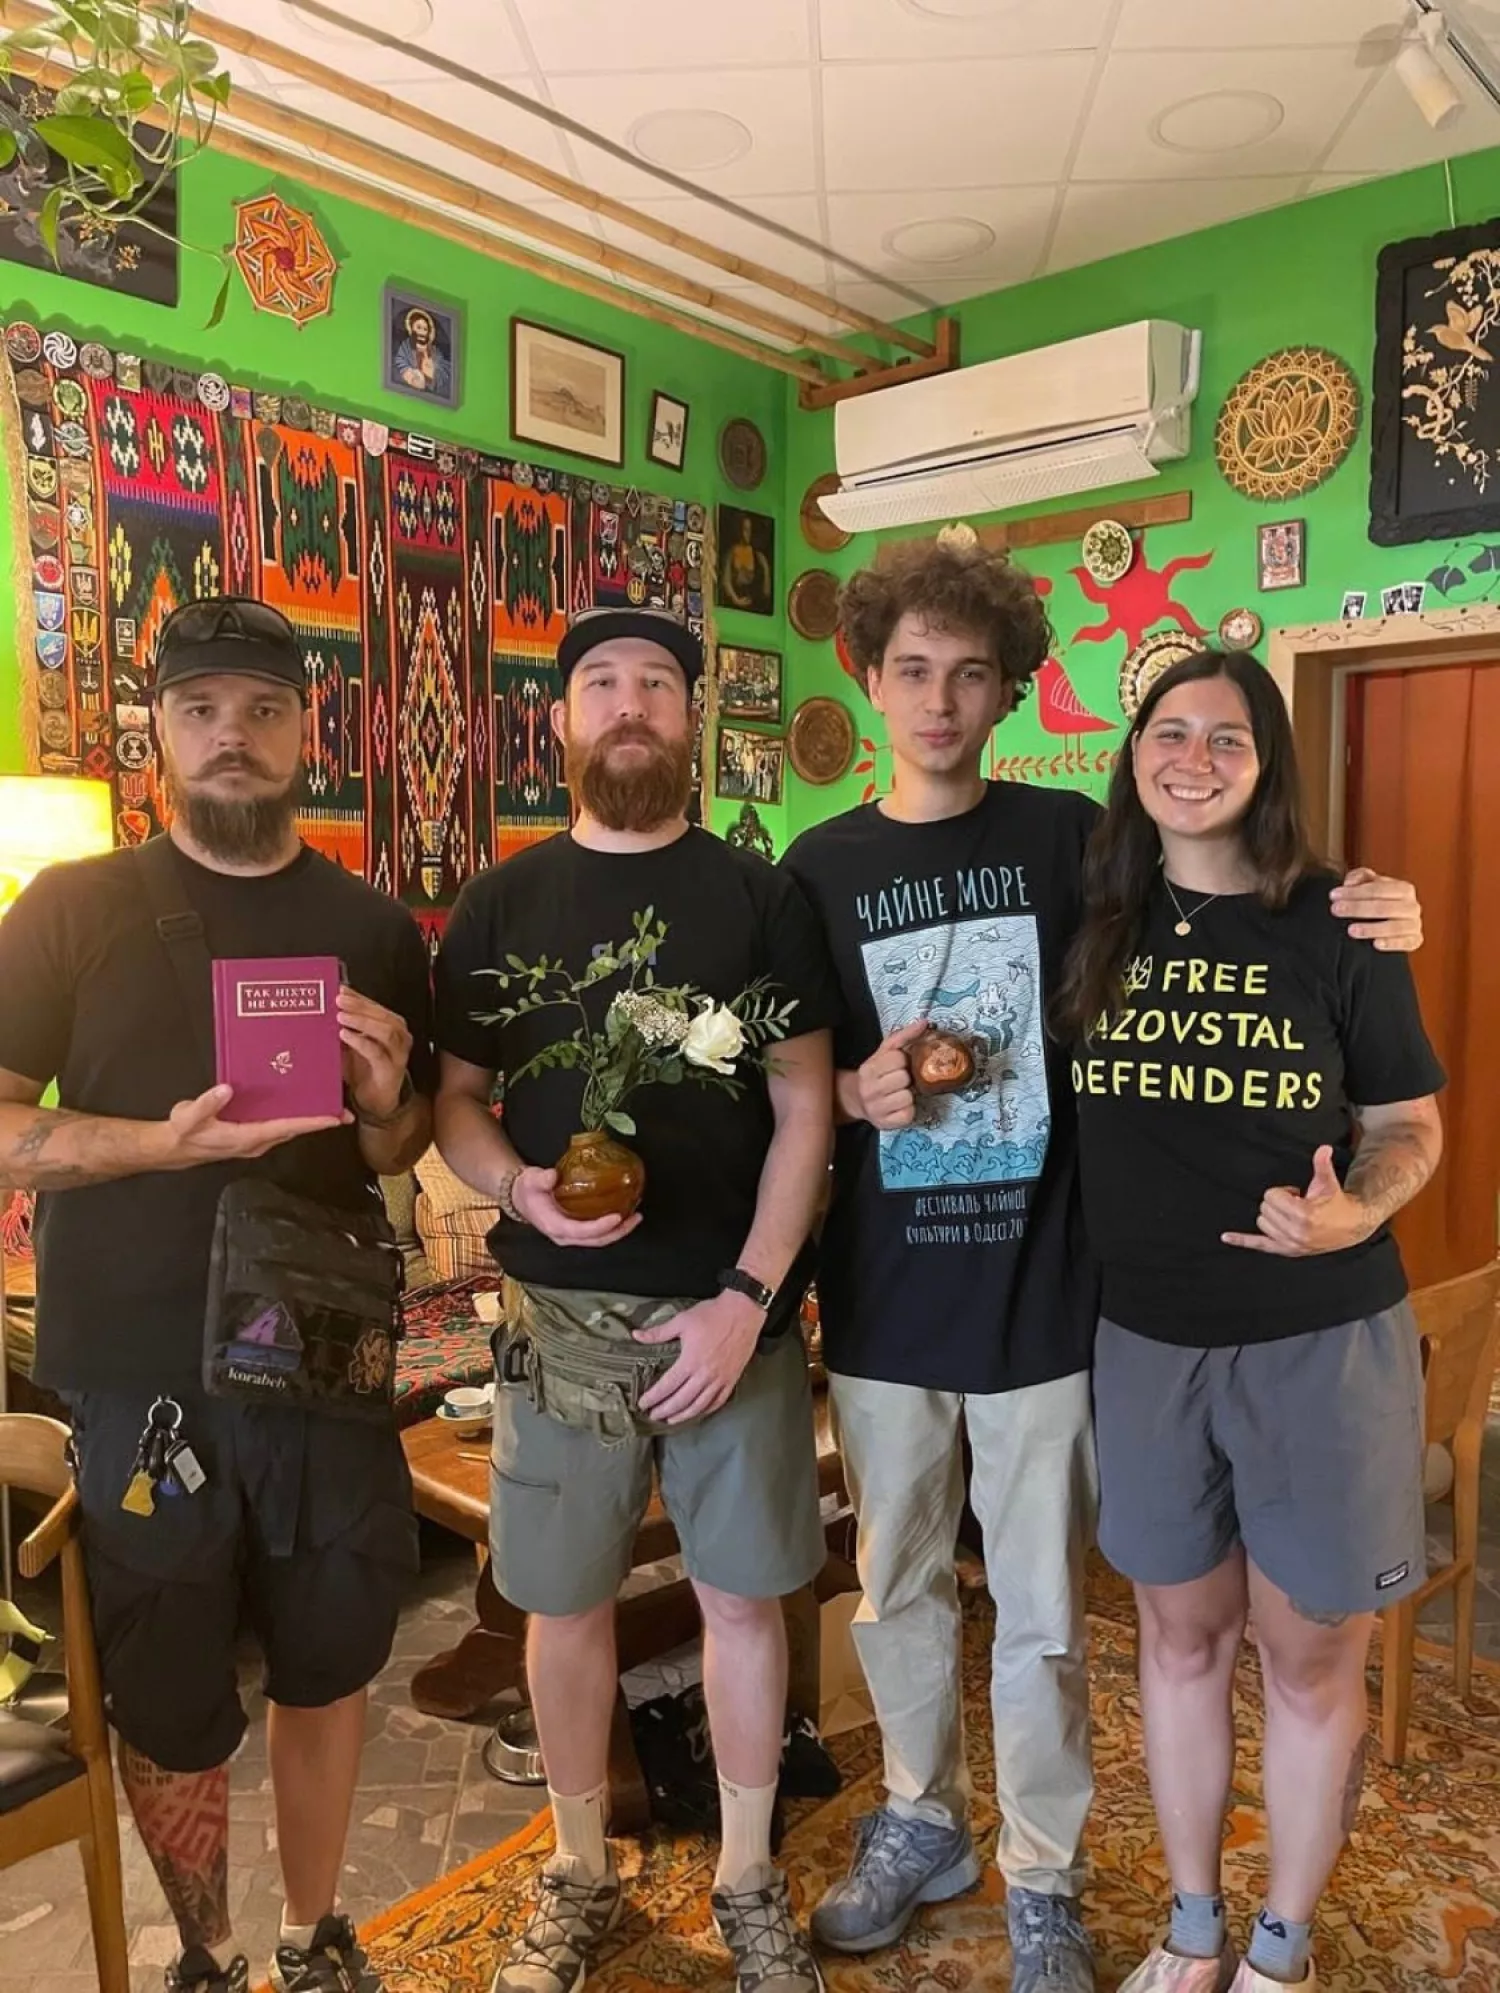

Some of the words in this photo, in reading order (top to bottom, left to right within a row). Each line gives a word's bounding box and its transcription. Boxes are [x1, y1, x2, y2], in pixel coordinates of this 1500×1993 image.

[856, 875, 949, 933] ЧАЙНЕ
[955, 865, 1032, 913] МОРЕ
[244, 988, 271, 998] ТАК
[275, 987, 317, 997] НІХТО
[1162, 958, 1269, 995] FREE
[247, 1001, 266, 1009] НЕ
[271, 998, 315, 1008] КОХАВ
[1071, 1059, 1323, 1110] DEFENDERS
